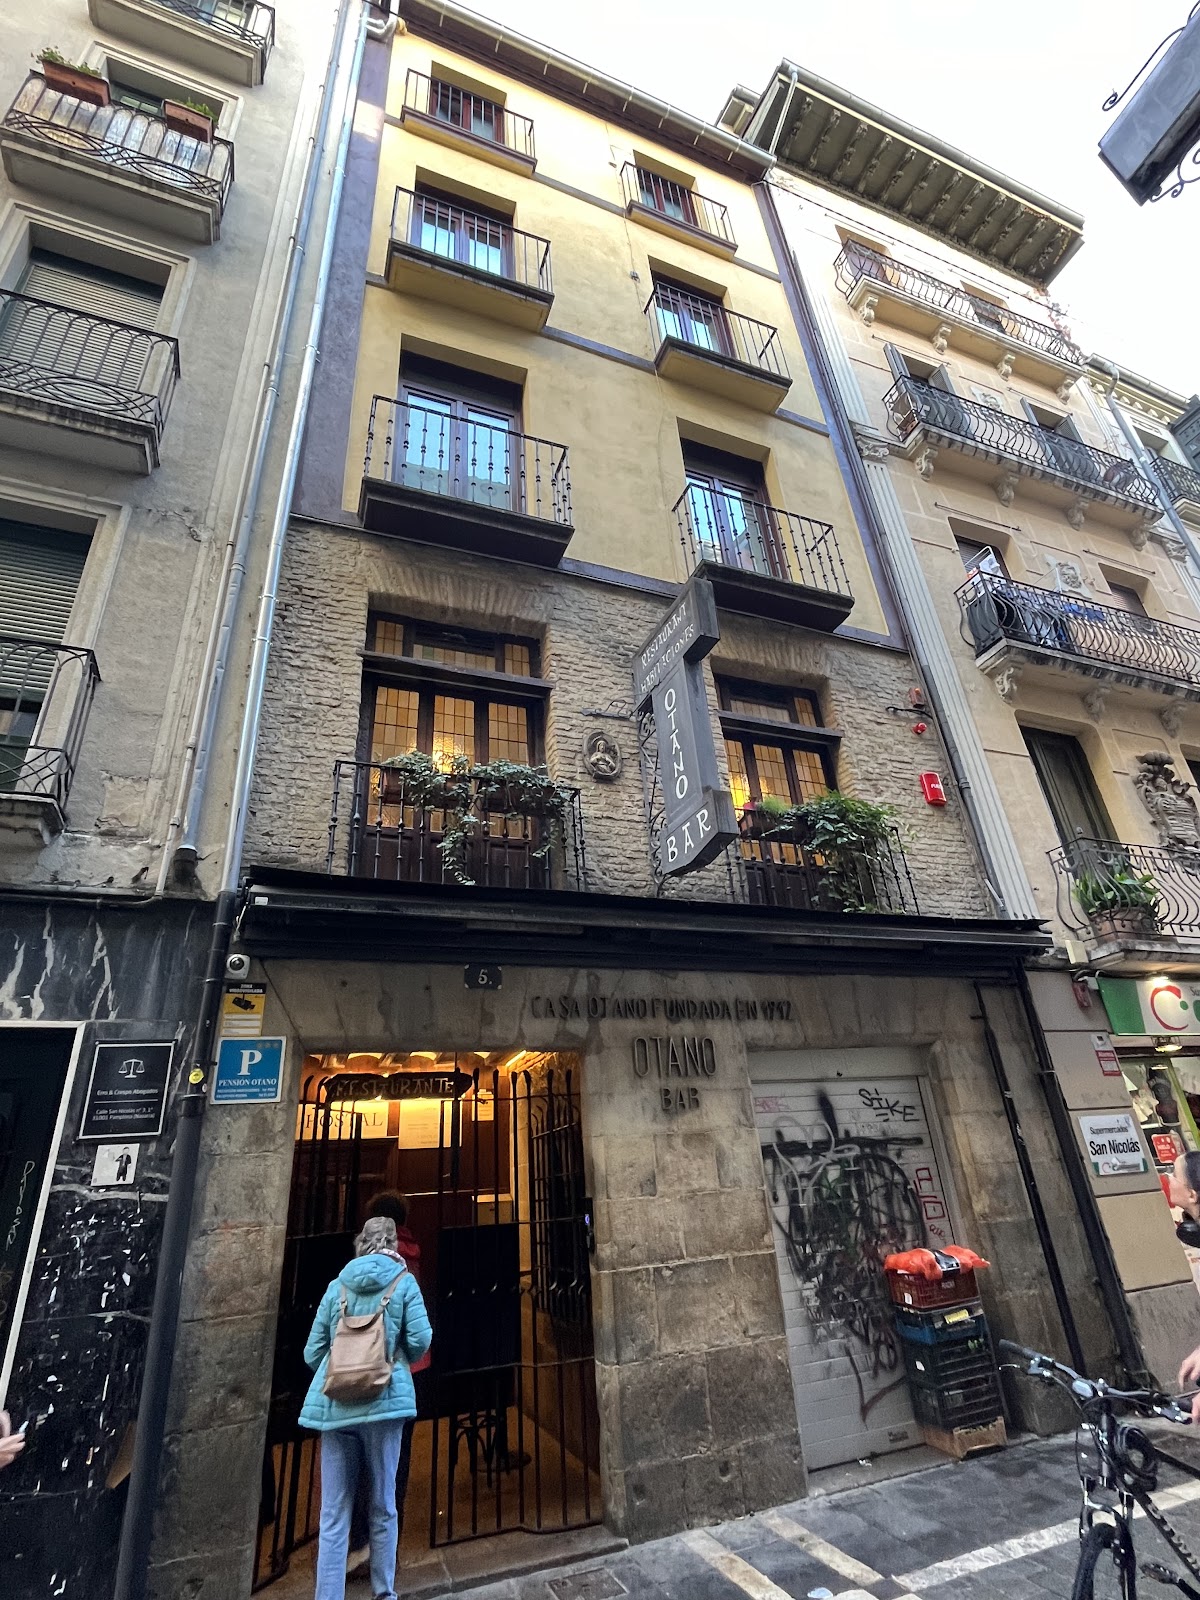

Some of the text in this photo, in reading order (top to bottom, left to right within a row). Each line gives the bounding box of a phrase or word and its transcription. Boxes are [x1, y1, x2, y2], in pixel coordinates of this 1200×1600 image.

[641, 602, 686, 669] RESTAURANT
[664, 688, 688, 799] OTANO
[666, 809, 711, 862] BAR
[531, 996, 580, 1019] CASA
[587, 996, 647, 1019] OTANO
[652, 998, 732, 1020] FUNDADA
[735, 998, 758, 1020] EN
[237, 1049, 262, 1076] P
[632, 1036, 716, 1078] OTANO
[218, 1077, 277, 1087] PENSIÓN OTANO
[661, 1086, 700, 1110] BAR
[1089, 1126, 1129, 1136] Supermercados
[1089, 1140, 1108, 1156] San
[1107, 1138, 1141, 1155] Nicolás
